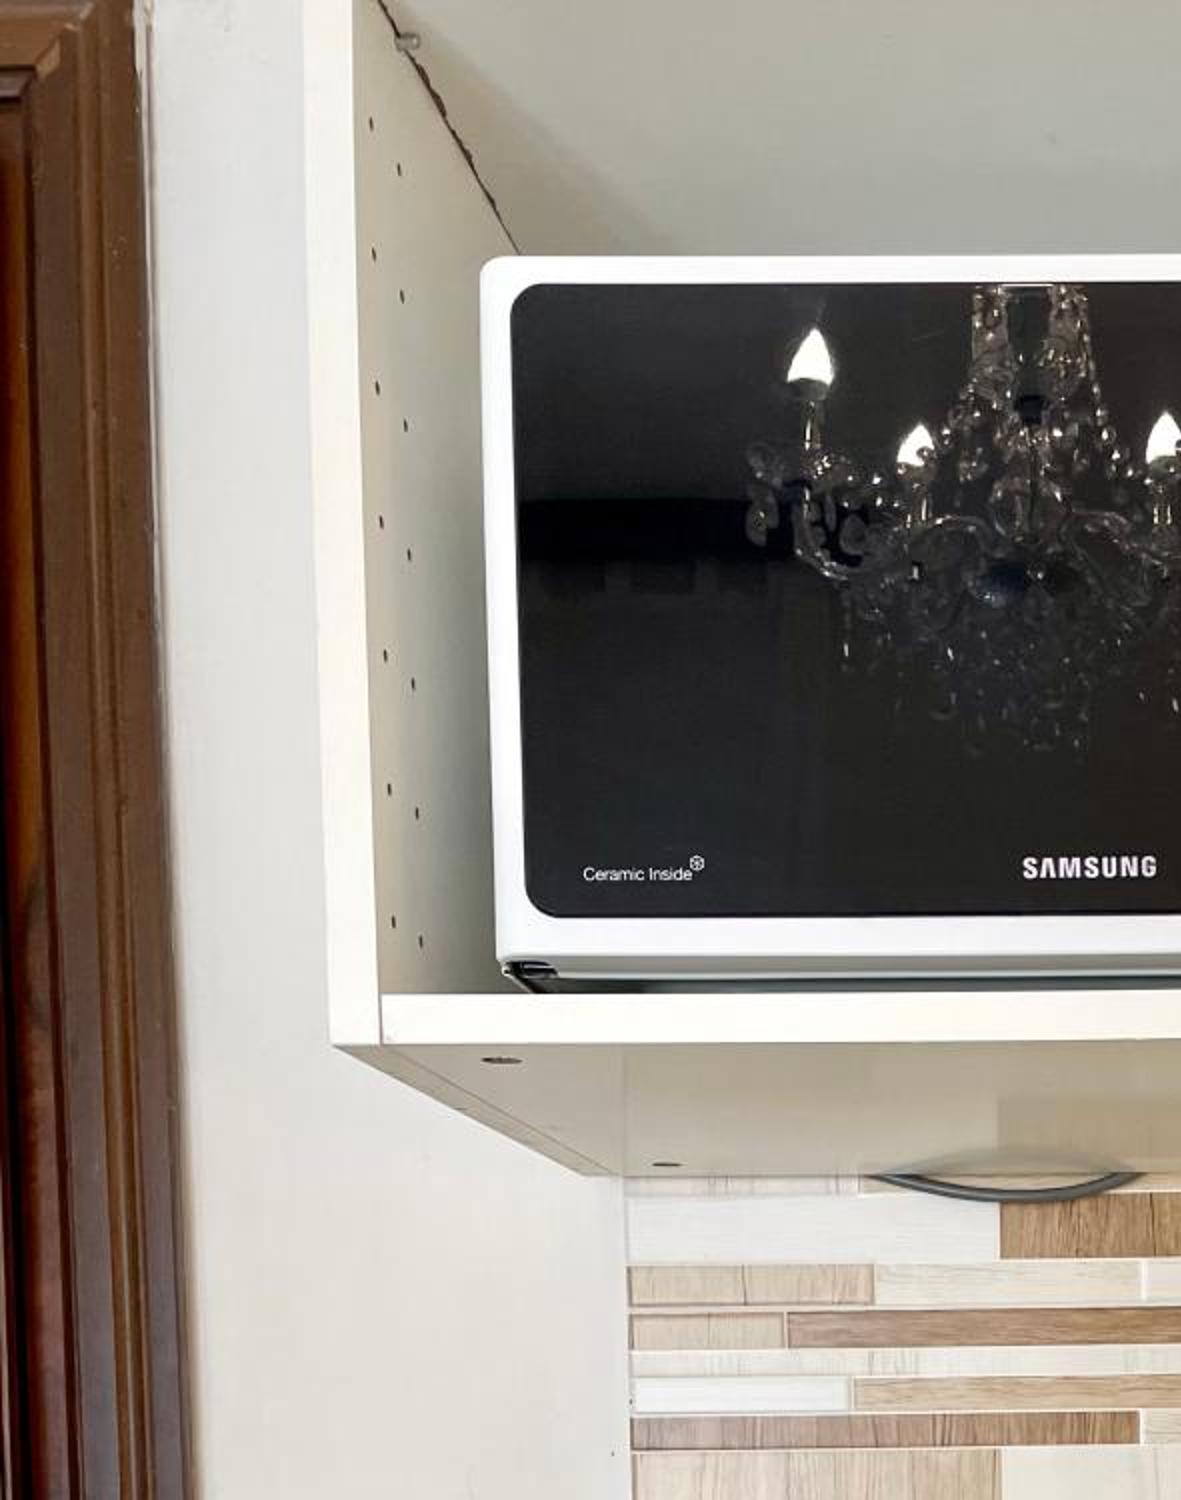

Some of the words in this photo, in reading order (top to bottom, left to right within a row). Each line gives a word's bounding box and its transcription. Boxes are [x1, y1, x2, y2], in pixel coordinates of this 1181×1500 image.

[582, 866, 645, 881] Ceramic
[649, 866, 694, 881] Inside
[1022, 855, 1158, 879] SAMSUNG
